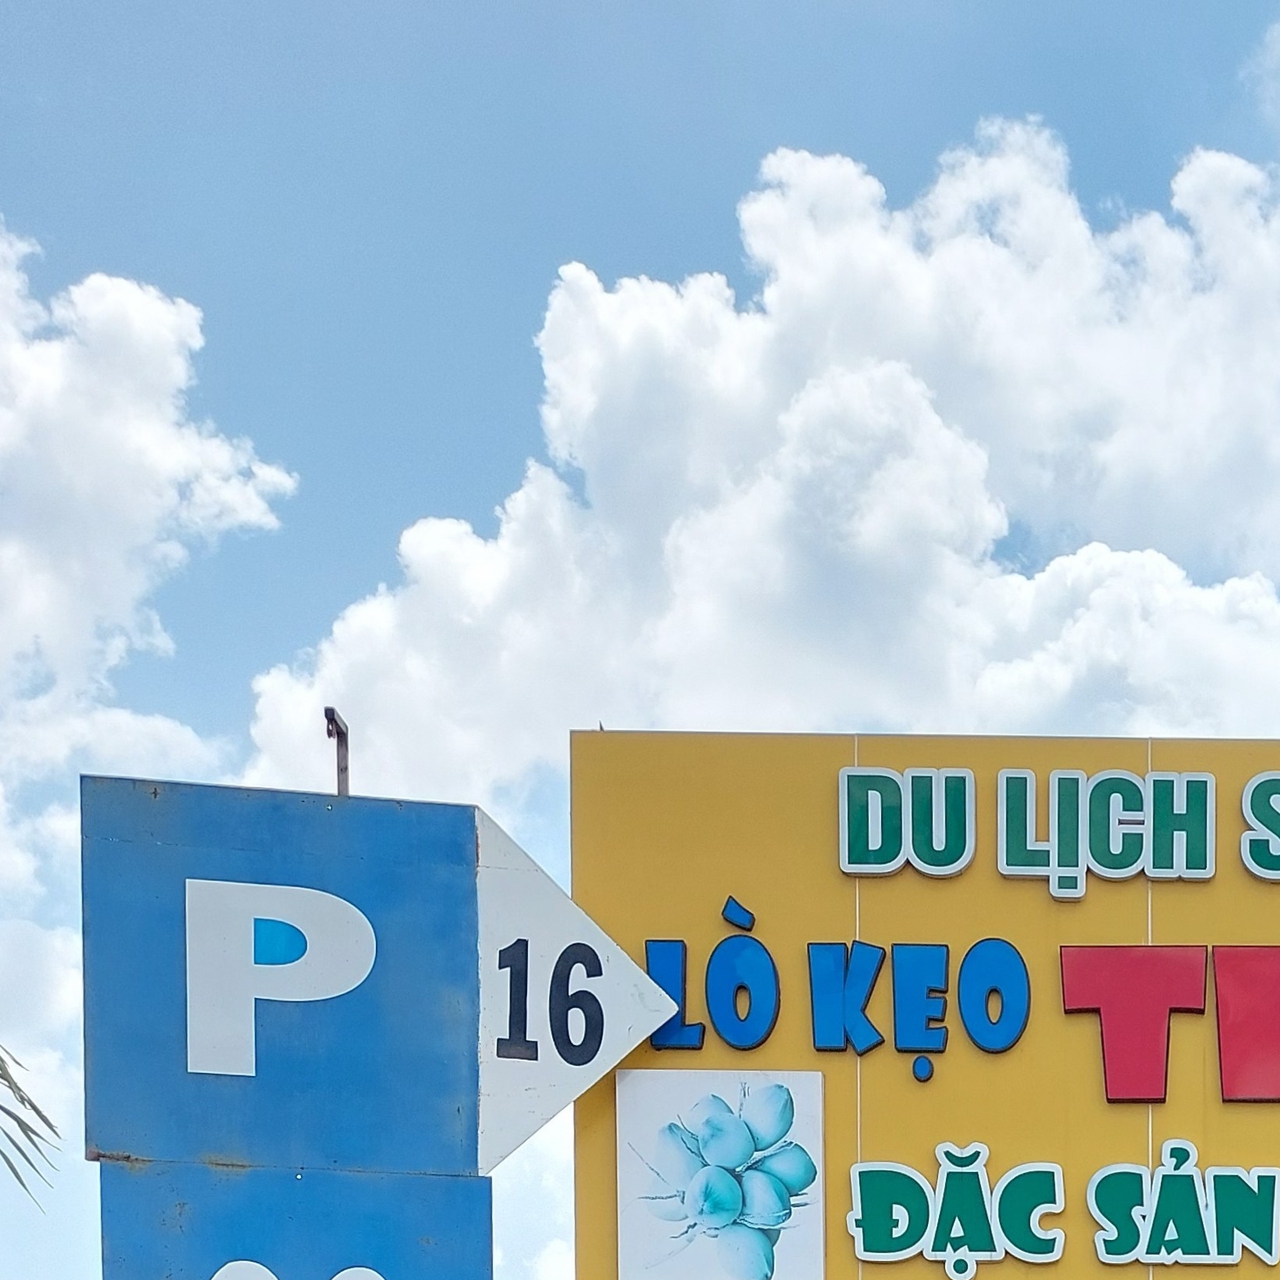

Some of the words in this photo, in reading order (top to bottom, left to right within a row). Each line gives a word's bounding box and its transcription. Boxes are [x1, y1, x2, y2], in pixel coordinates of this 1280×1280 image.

[840, 770, 974, 874] DU
[998, 771, 1215, 899] LỊCH
[186, 878, 376, 1077] P
[495, 938, 604, 1067] 16
[645, 896, 780, 1051] LÒ
[808, 938, 1031, 1082] KẸO
